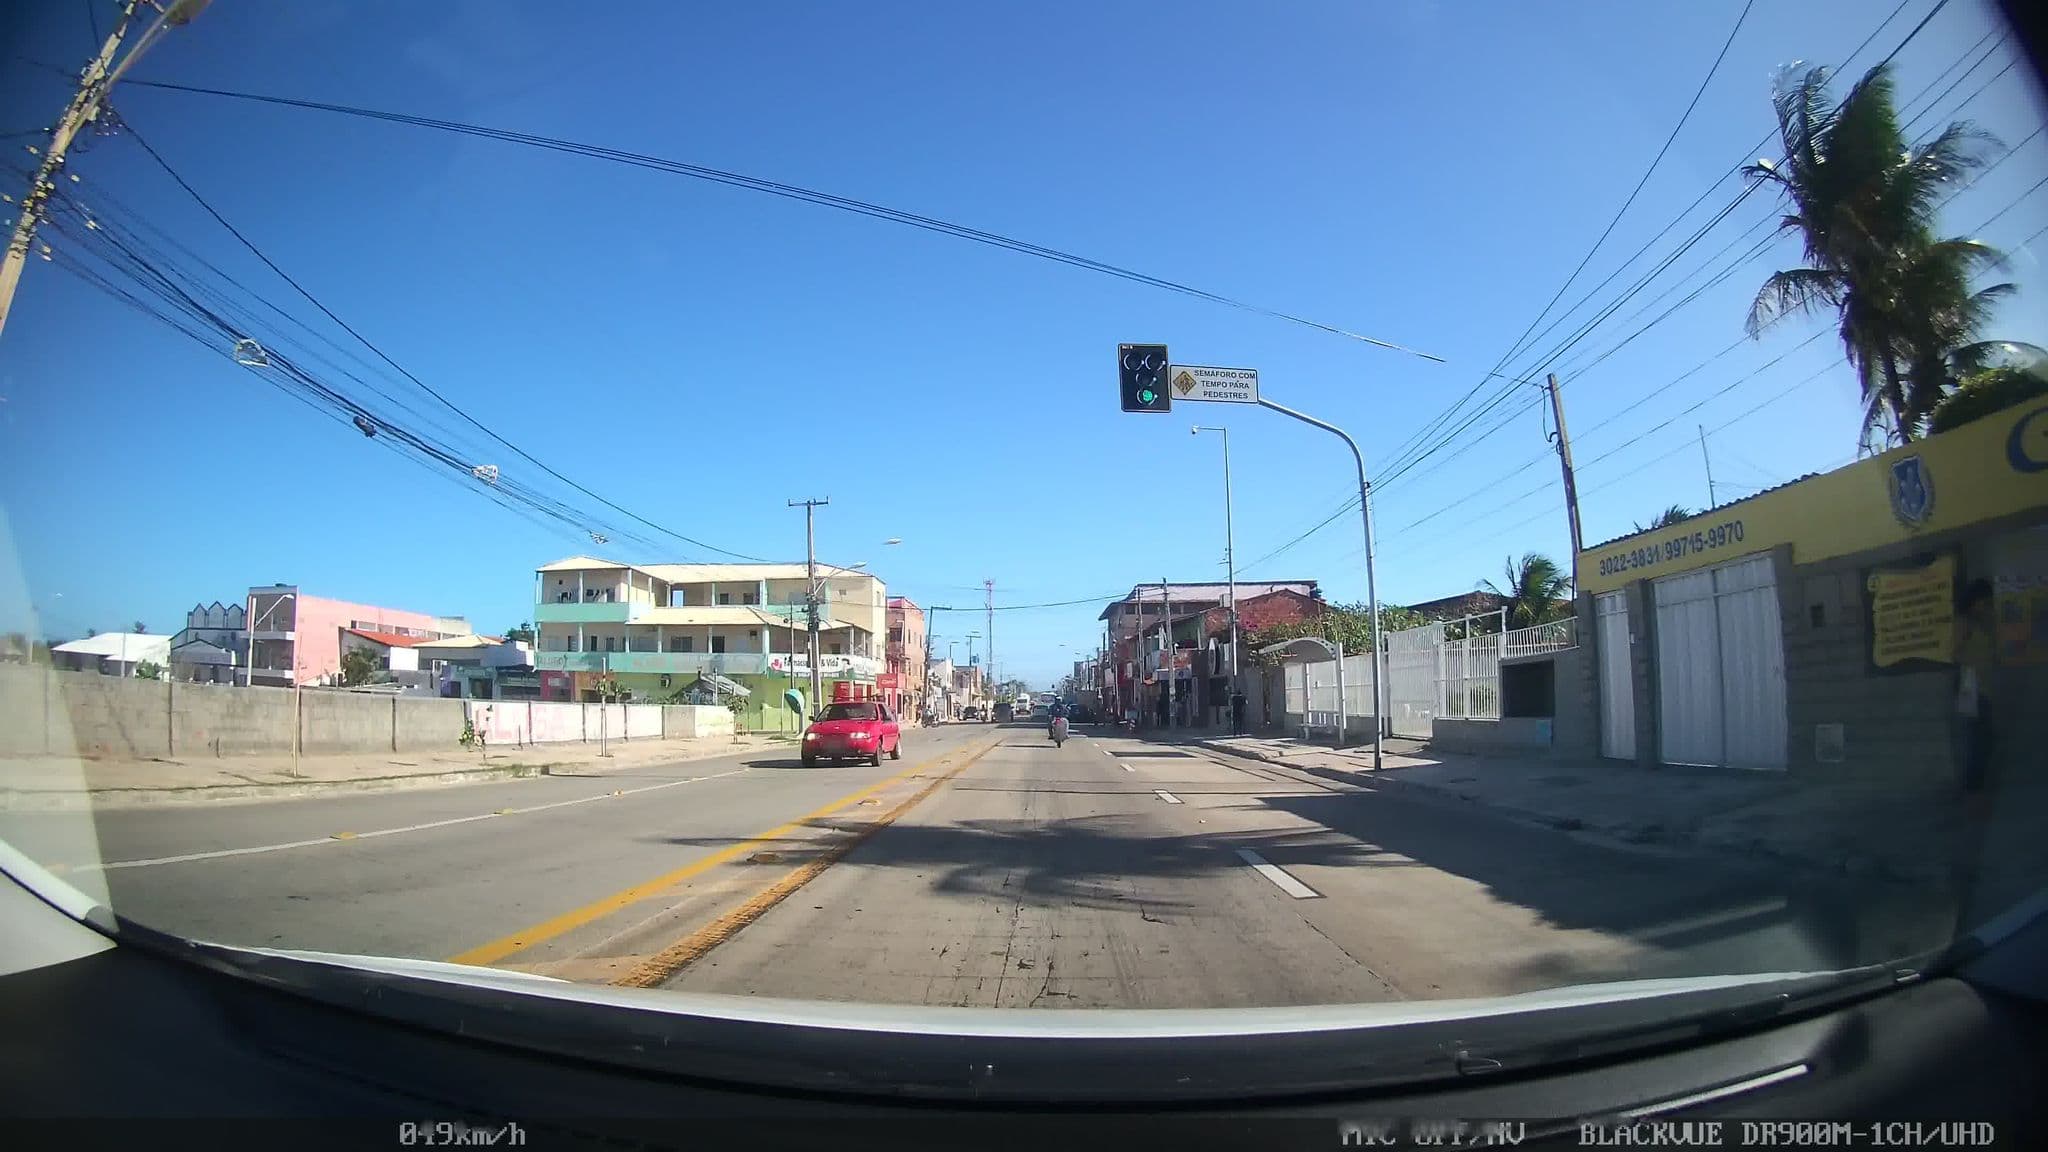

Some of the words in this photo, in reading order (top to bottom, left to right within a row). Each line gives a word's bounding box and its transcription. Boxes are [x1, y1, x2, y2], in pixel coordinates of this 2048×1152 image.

[1238, 372, 1256, 380] COM
[1201, 380, 1228, 388] TEMPO
[1203, 391, 1249, 399] PEDESTRES
